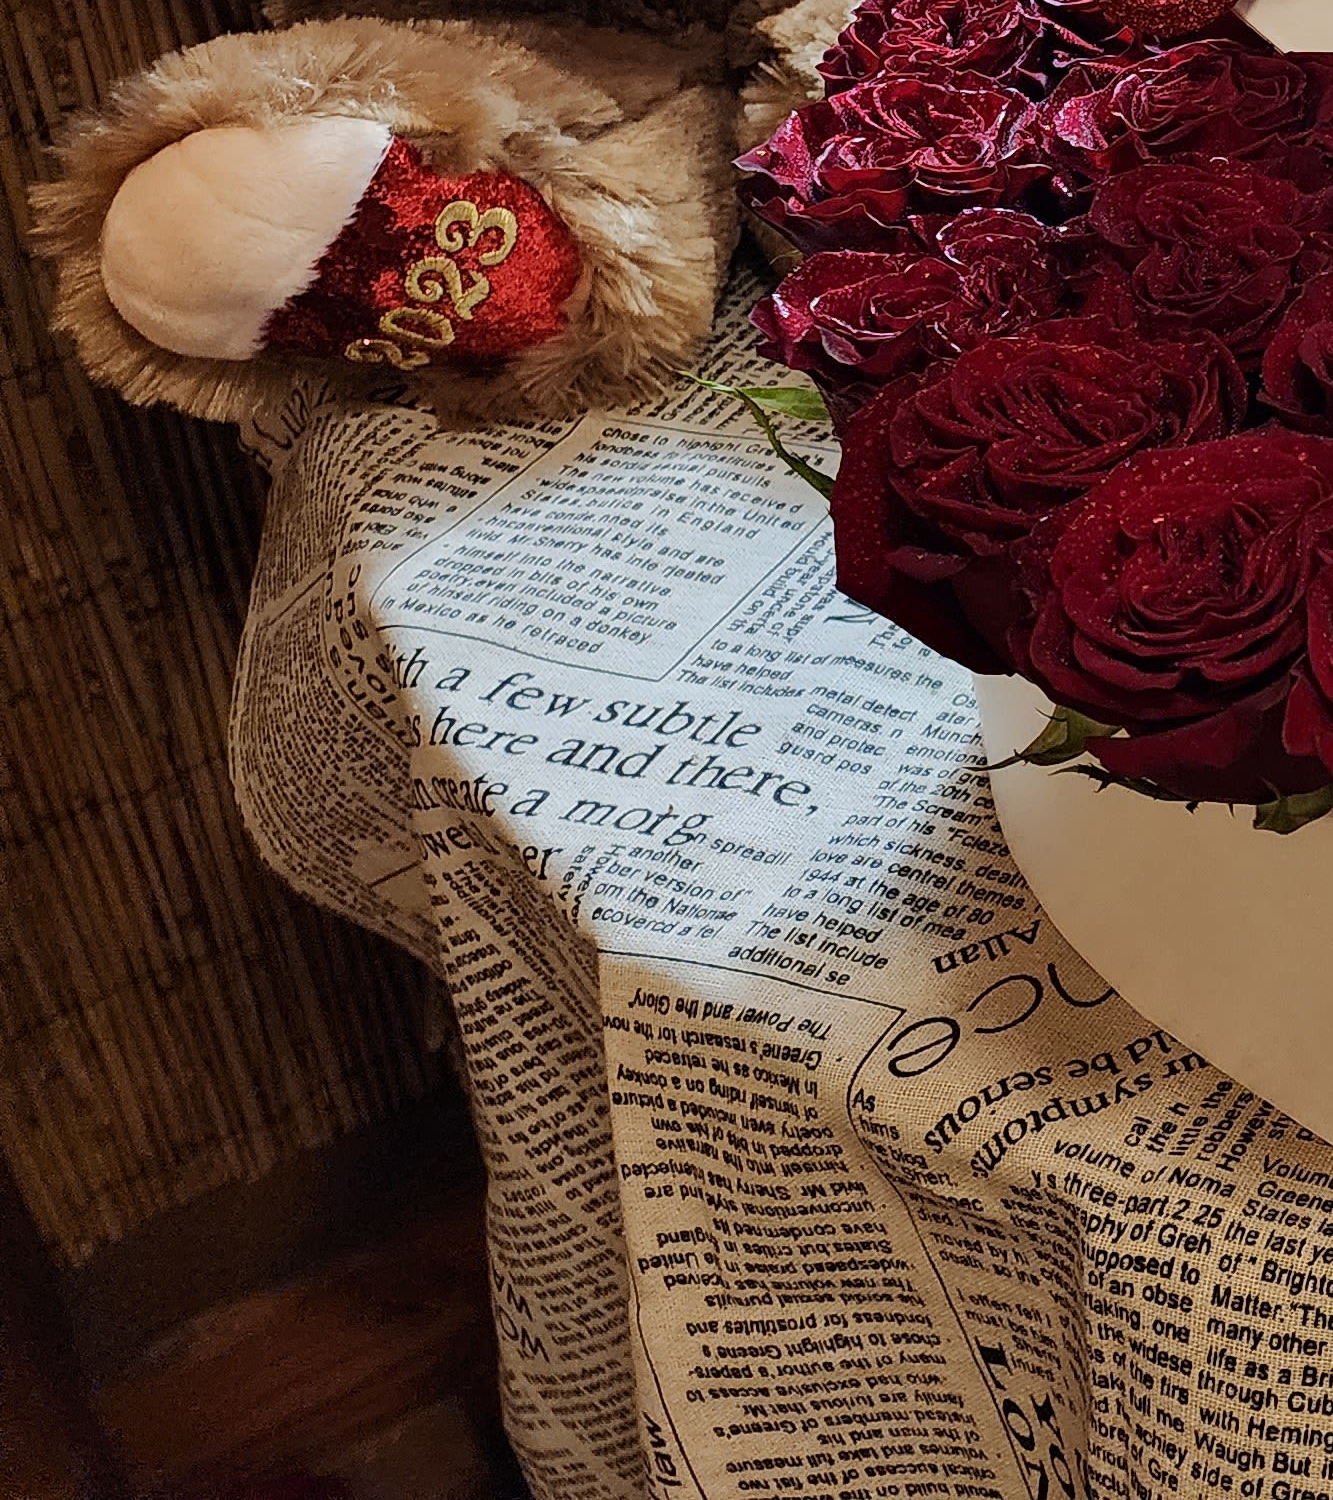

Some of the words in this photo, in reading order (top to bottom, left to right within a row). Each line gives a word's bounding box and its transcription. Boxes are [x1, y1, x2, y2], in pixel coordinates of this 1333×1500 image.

[345, 199, 519, 372] 2023
[435, 667, 472, 692] a
[479, 671, 596, 719] few
[595, 699, 762, 749] subtle
[428, 705, 539, 756] here
[546, 737, 668, 779] and
[666, 754, 819, 817] there,
[510, 788, 550, 817] a
[810, 851, 847, 864] love
[852, 855, 883, 868] are
[888, 861, 954, 892] central
[675, 999, 698, 1019] the
[702, 1001, 734, 1021] and
[797, 1018, 833, 1041] The
[1064, 1052, 1122, 1078] be
[923, 1065, 1053, 1155] serious
[1224, 1218, 1260, 1246] the
[1264, 1229, 1307, 1259] last
[1207, 1317, 1264, 1351] many
[1268, 1331, 1327, 1357] other
[1206, 1345, 1237, 1373] life
[1245, 1360, 1269, 1380] as
[1278, 1368, 1292, 1385] a
[1198, 1369, 1279, 1411] through
[1194, 1430, 1266, 1472] Waugh
